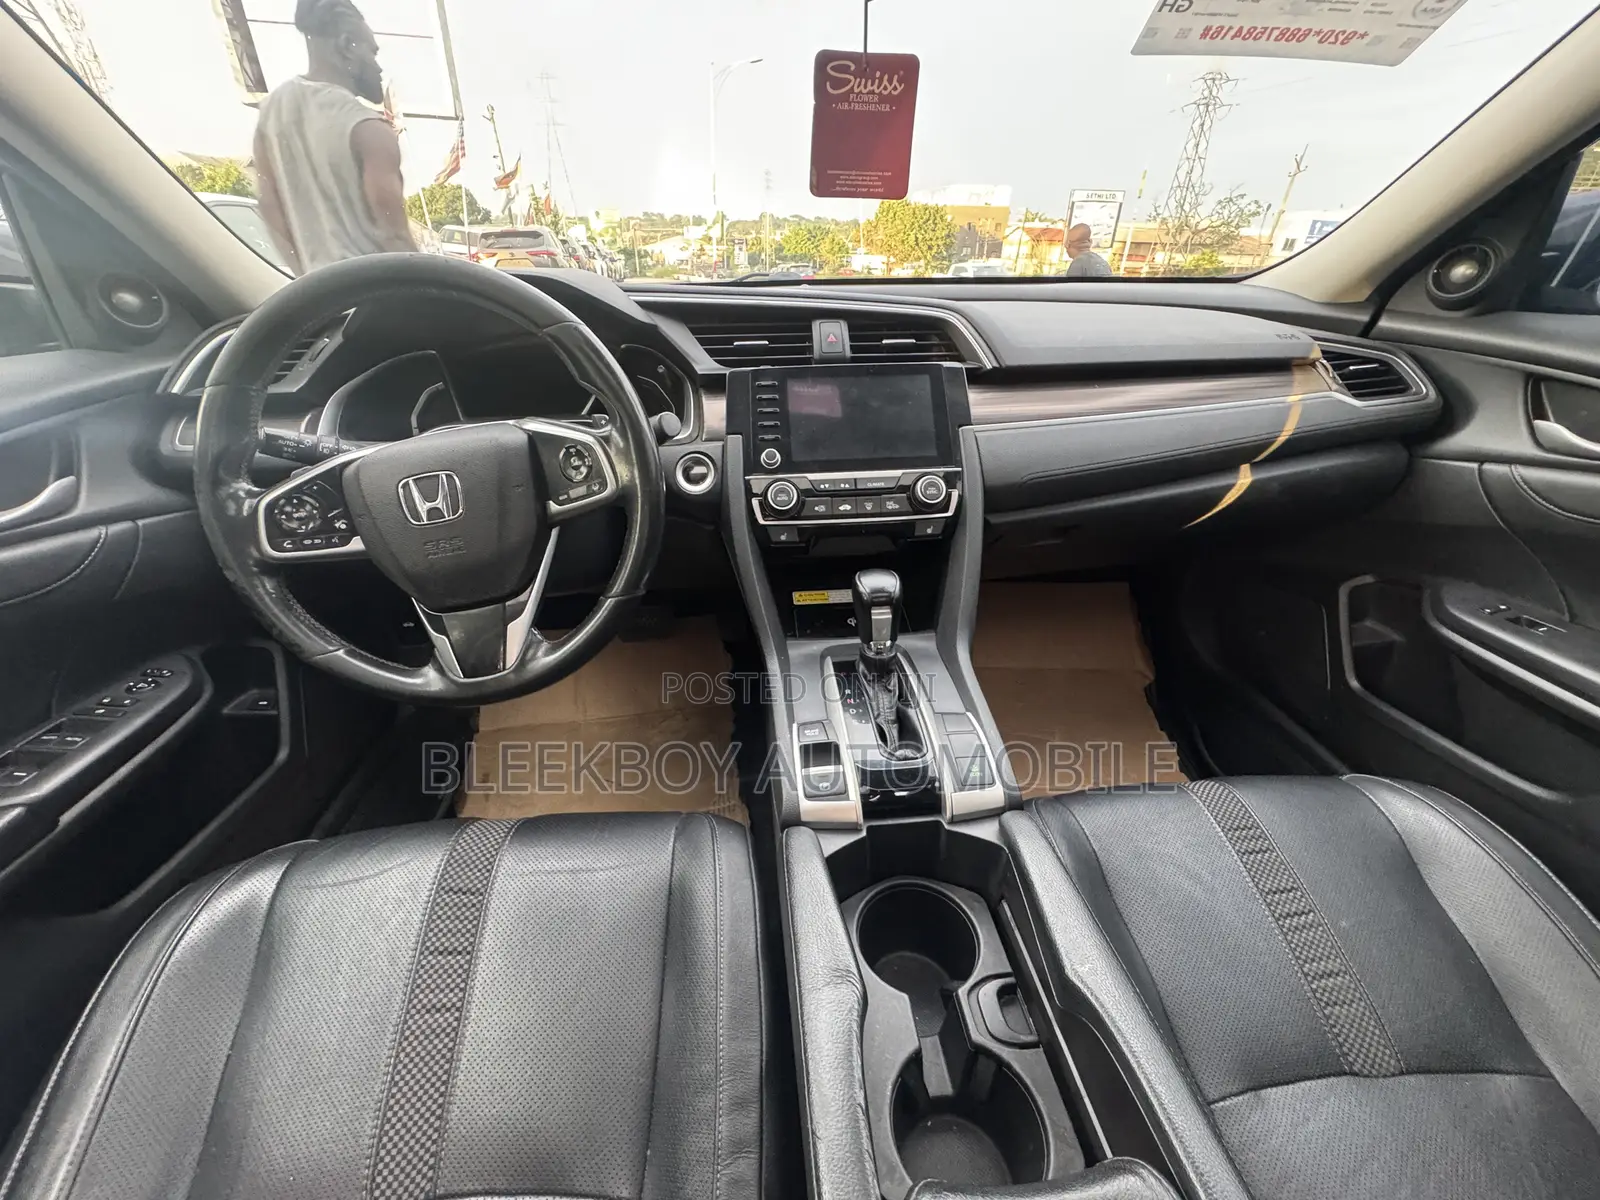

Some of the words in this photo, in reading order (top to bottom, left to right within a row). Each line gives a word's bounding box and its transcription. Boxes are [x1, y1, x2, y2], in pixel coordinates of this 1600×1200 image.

[826, 60, 905, 95] Swiss
[849, 93, 879, 103] FLOWER
[836, 102, 891, 112] AIR-FRESHENER
